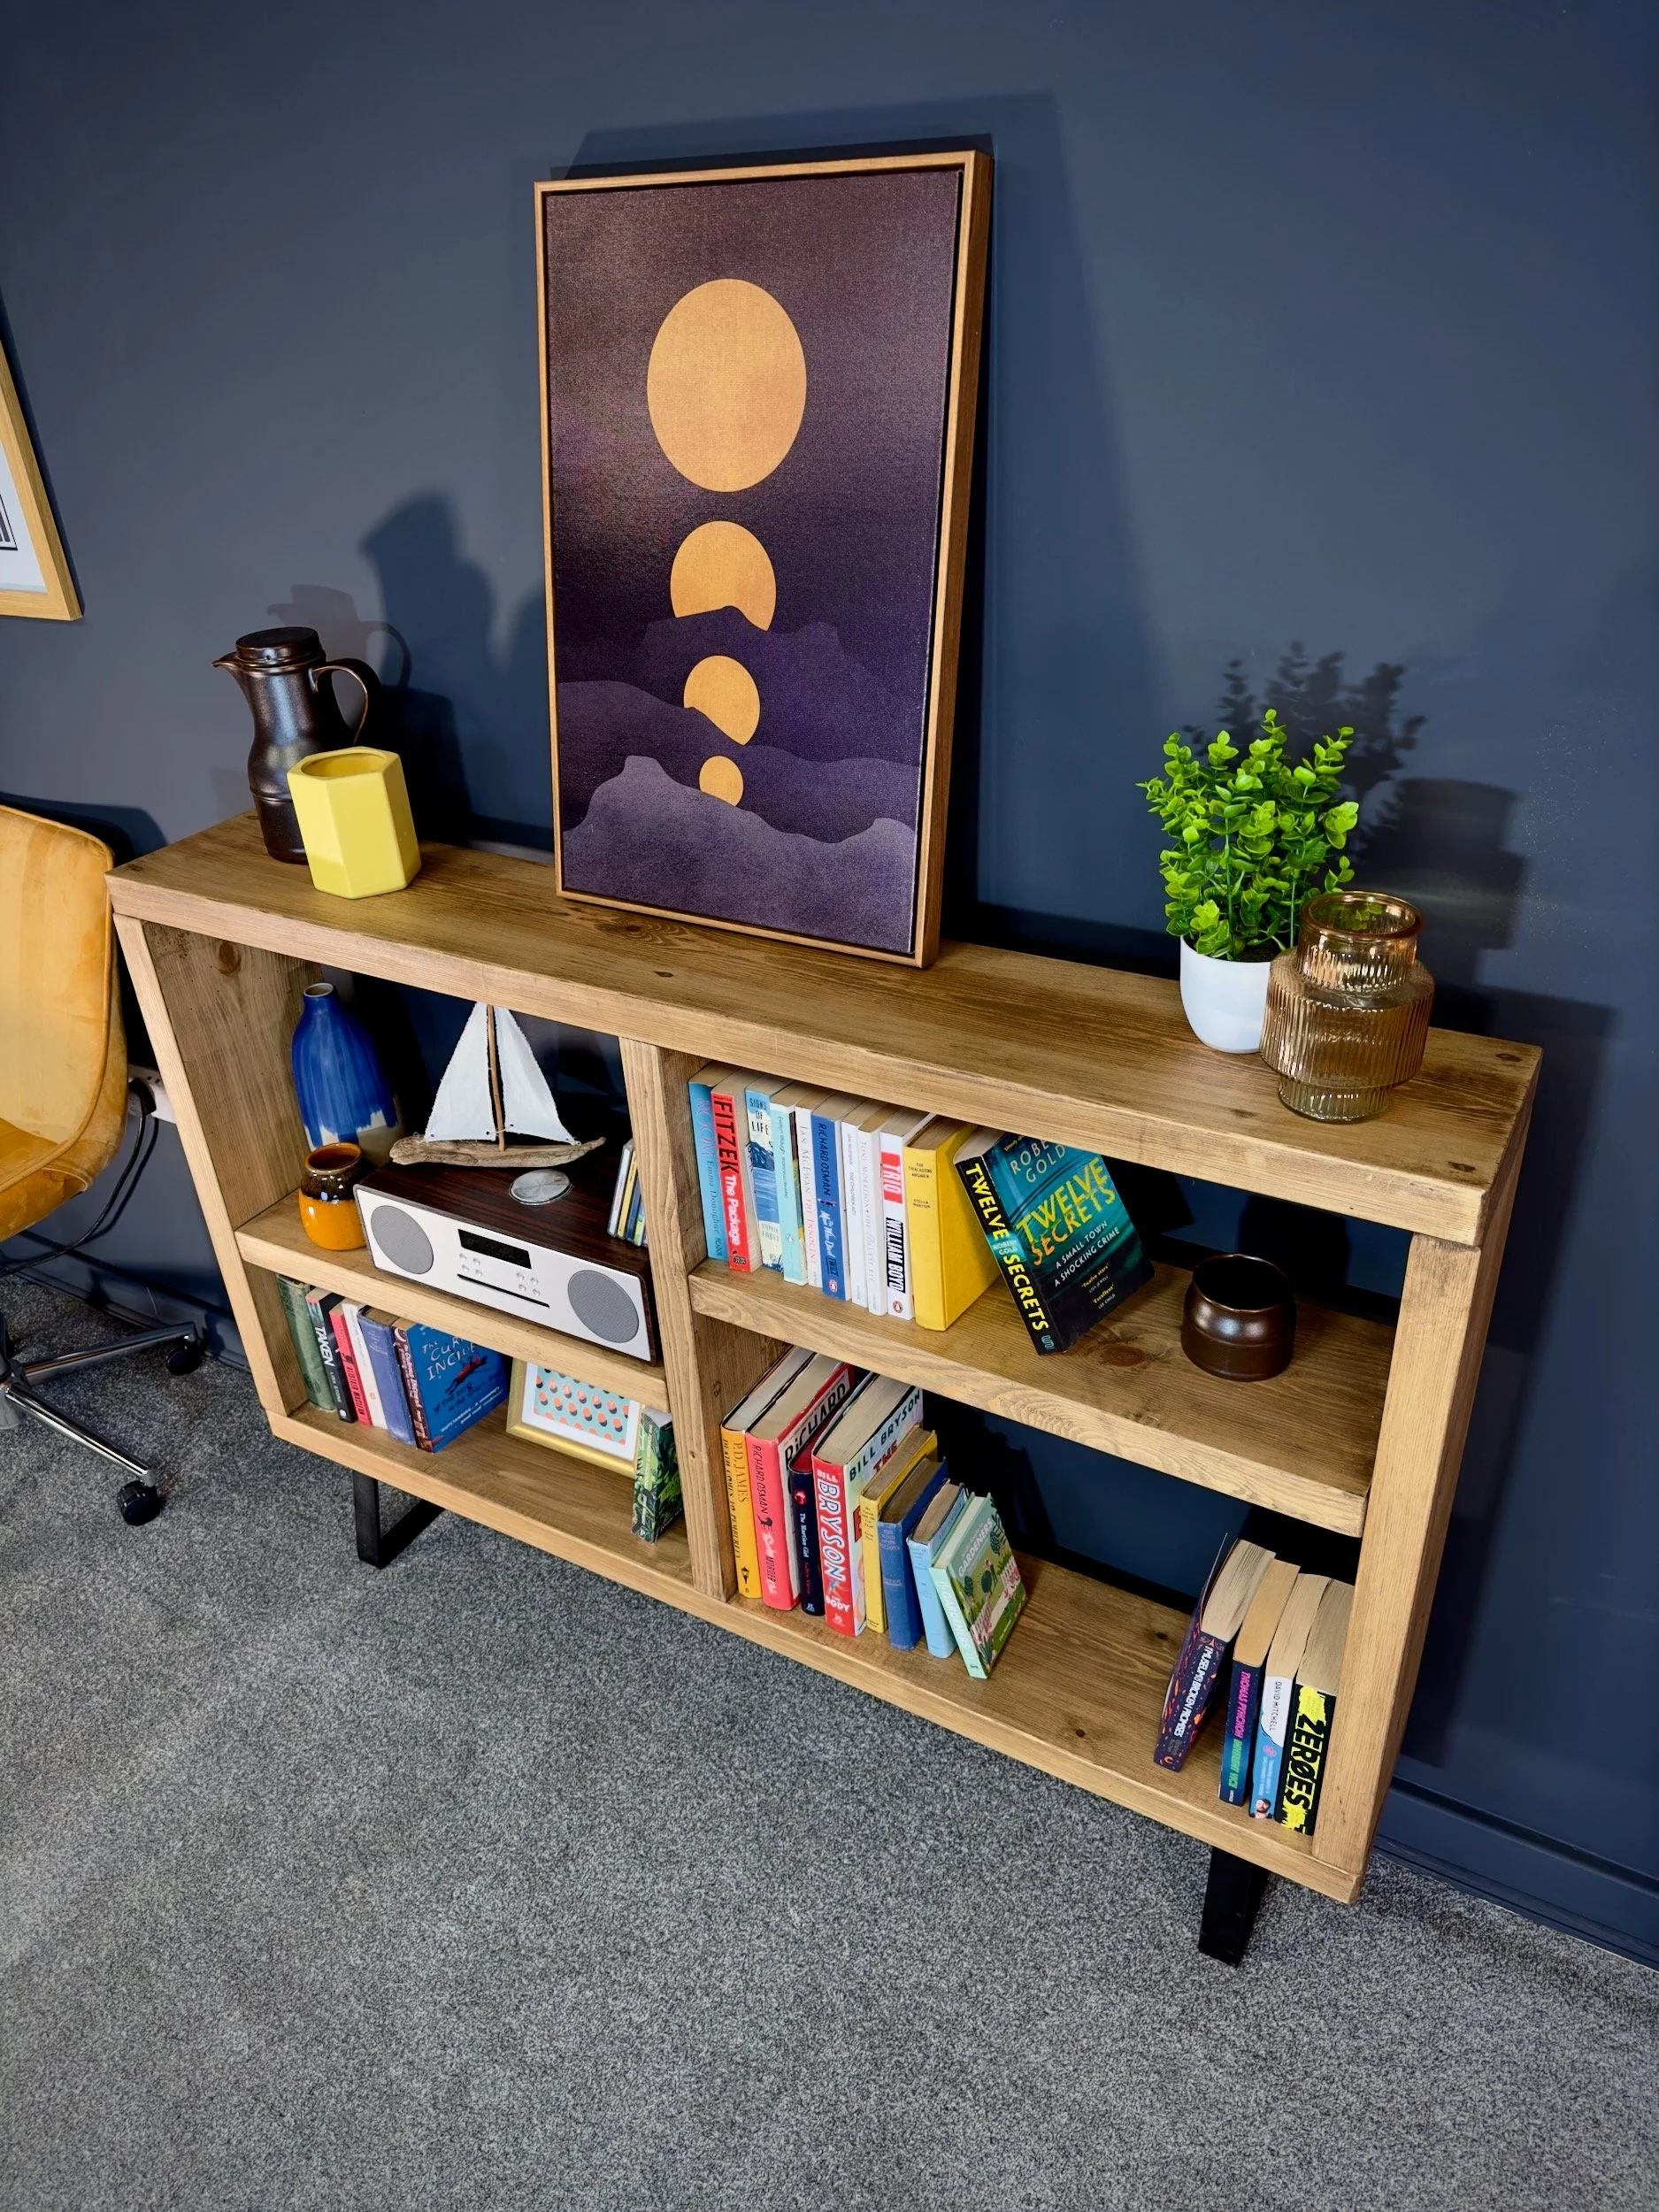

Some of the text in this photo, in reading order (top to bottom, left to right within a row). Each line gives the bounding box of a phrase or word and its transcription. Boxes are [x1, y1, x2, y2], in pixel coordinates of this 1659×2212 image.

[749, 1098, 767, 1110] SIGNS
[713, 1100, 740, 1174] FITZEK
[751, 1121, 769, 1135] LIFE
[820, 1163, 832, 1196] OSMAN
[882, 1164, 902, 1194] TRIO
[1025, 1144, 1066, 1183] GOLD
[725, 1174, 737, 1196] The
[966, 1163, 1009, 1240] TWELVE
[1016, 1156, 1108, 1245] TWELVE
[727, 1197, 741, 1246] Package
[1031, 1185, 1116, 1266] SECRETS
[887, 1218, 904, 1292] WILLIAM BOYD
[1054, 1226, 1120, 1287] A SHOCKING CRIME
[1055, 1220, 1108, 1270] A SMALL TOWN
[1003, 1255, 1049, 1331] SECRETS
[315, 1325, 335, 1368] TAKEN
[849, 1390, 920, 1482] BILL BRYSON
[736, 1463, 749, 1502] JAMES
[817, 1469, 839, 1482] BILL
[757, 1482, 768, 1515] OSMAN
[817, 1478, 847, 1582] BRYSON
[958, 1517, 993, 1578] GARDENERS
[764, 1555, 777, 1585] MURDER
[825, 1595, 850, 1613] BODY
[1183, 1680, 1202, 1709] BROKEN
[1239, 1671, 1251, 1701] THOMAS
[1172, 1708, 1193, 1738] PROMISES
[1269, 1701, 1279, 1732] MITCHELL
